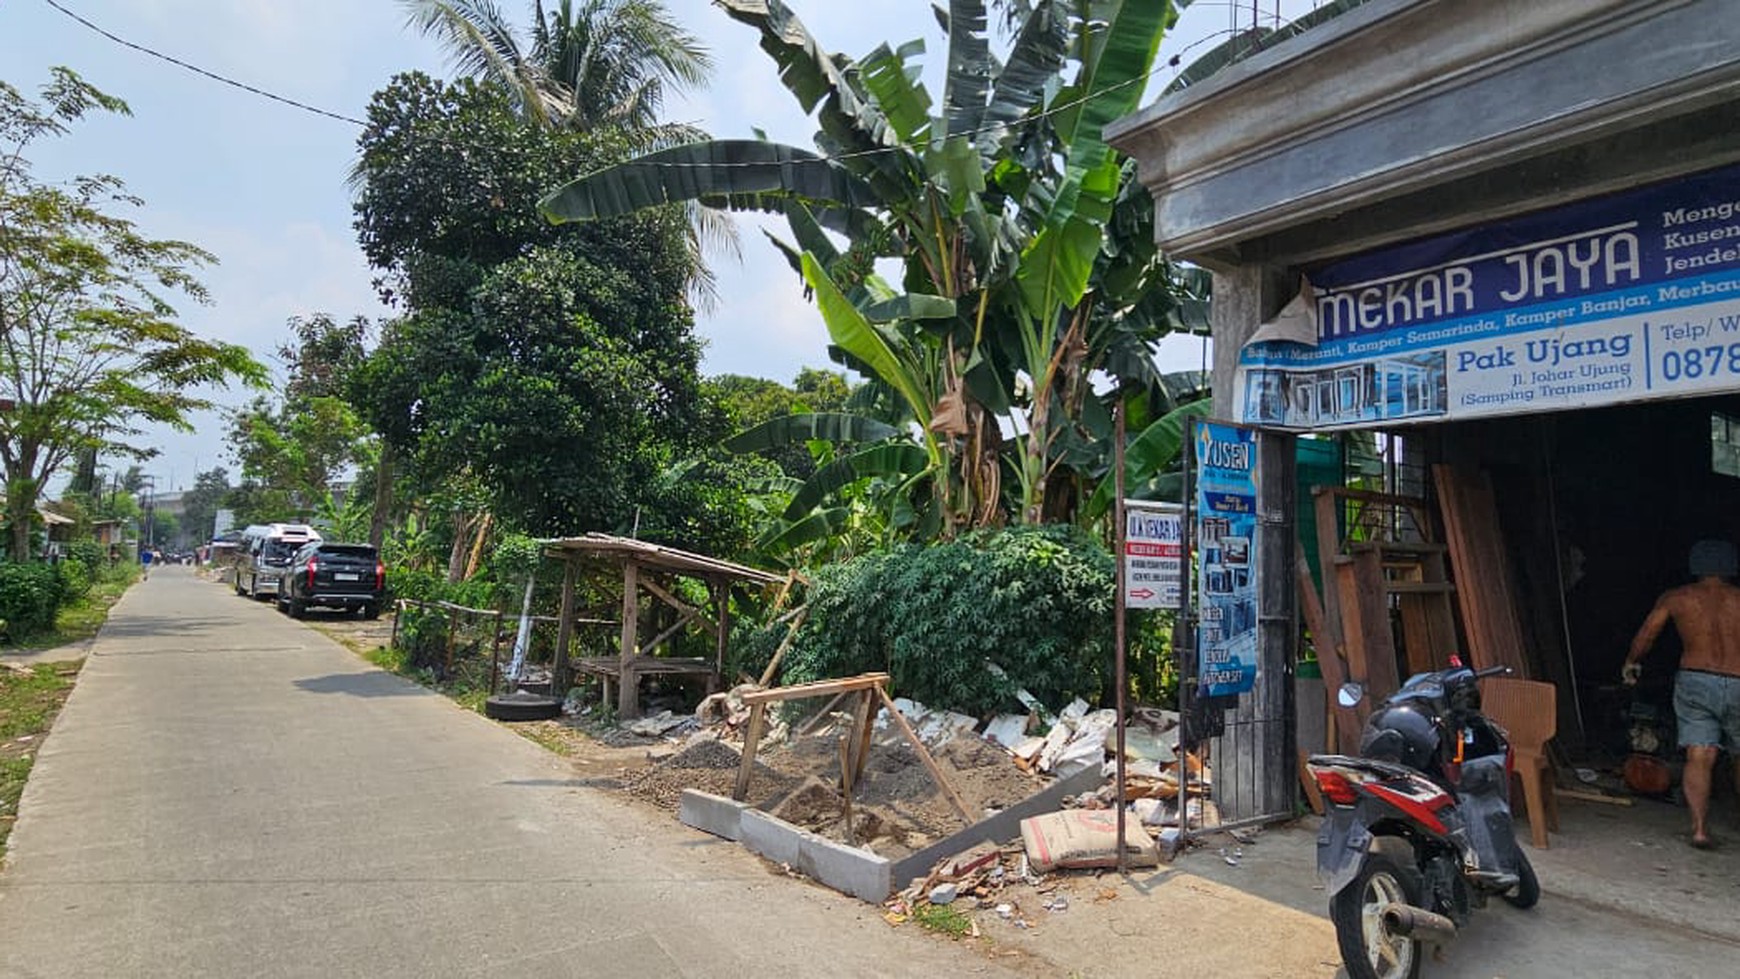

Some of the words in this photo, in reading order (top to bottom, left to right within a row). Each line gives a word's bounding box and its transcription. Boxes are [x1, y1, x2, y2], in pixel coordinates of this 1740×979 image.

[1319, 266, 1474, 338] MEKAR
[1500, 232, 1640, 302] JAYA
[1347, 337, 1402, 354] Kamper
[1407, 319, 1500, 344] Samarinda,
[1505, 306, 1576, 328] Kamper
[1582, 294, 1651, 315] Banjar,
[1457, 346, 1515, 372] Pak
[1525, 334, 1633, 366] Ujang
[1663, 342, 1740, 382] 0878
[1532, 369, 1575, 385] Johar
[1580, 362, 1631, 380] Ujung
[1204, 440, 1249, 470] KUSEN
